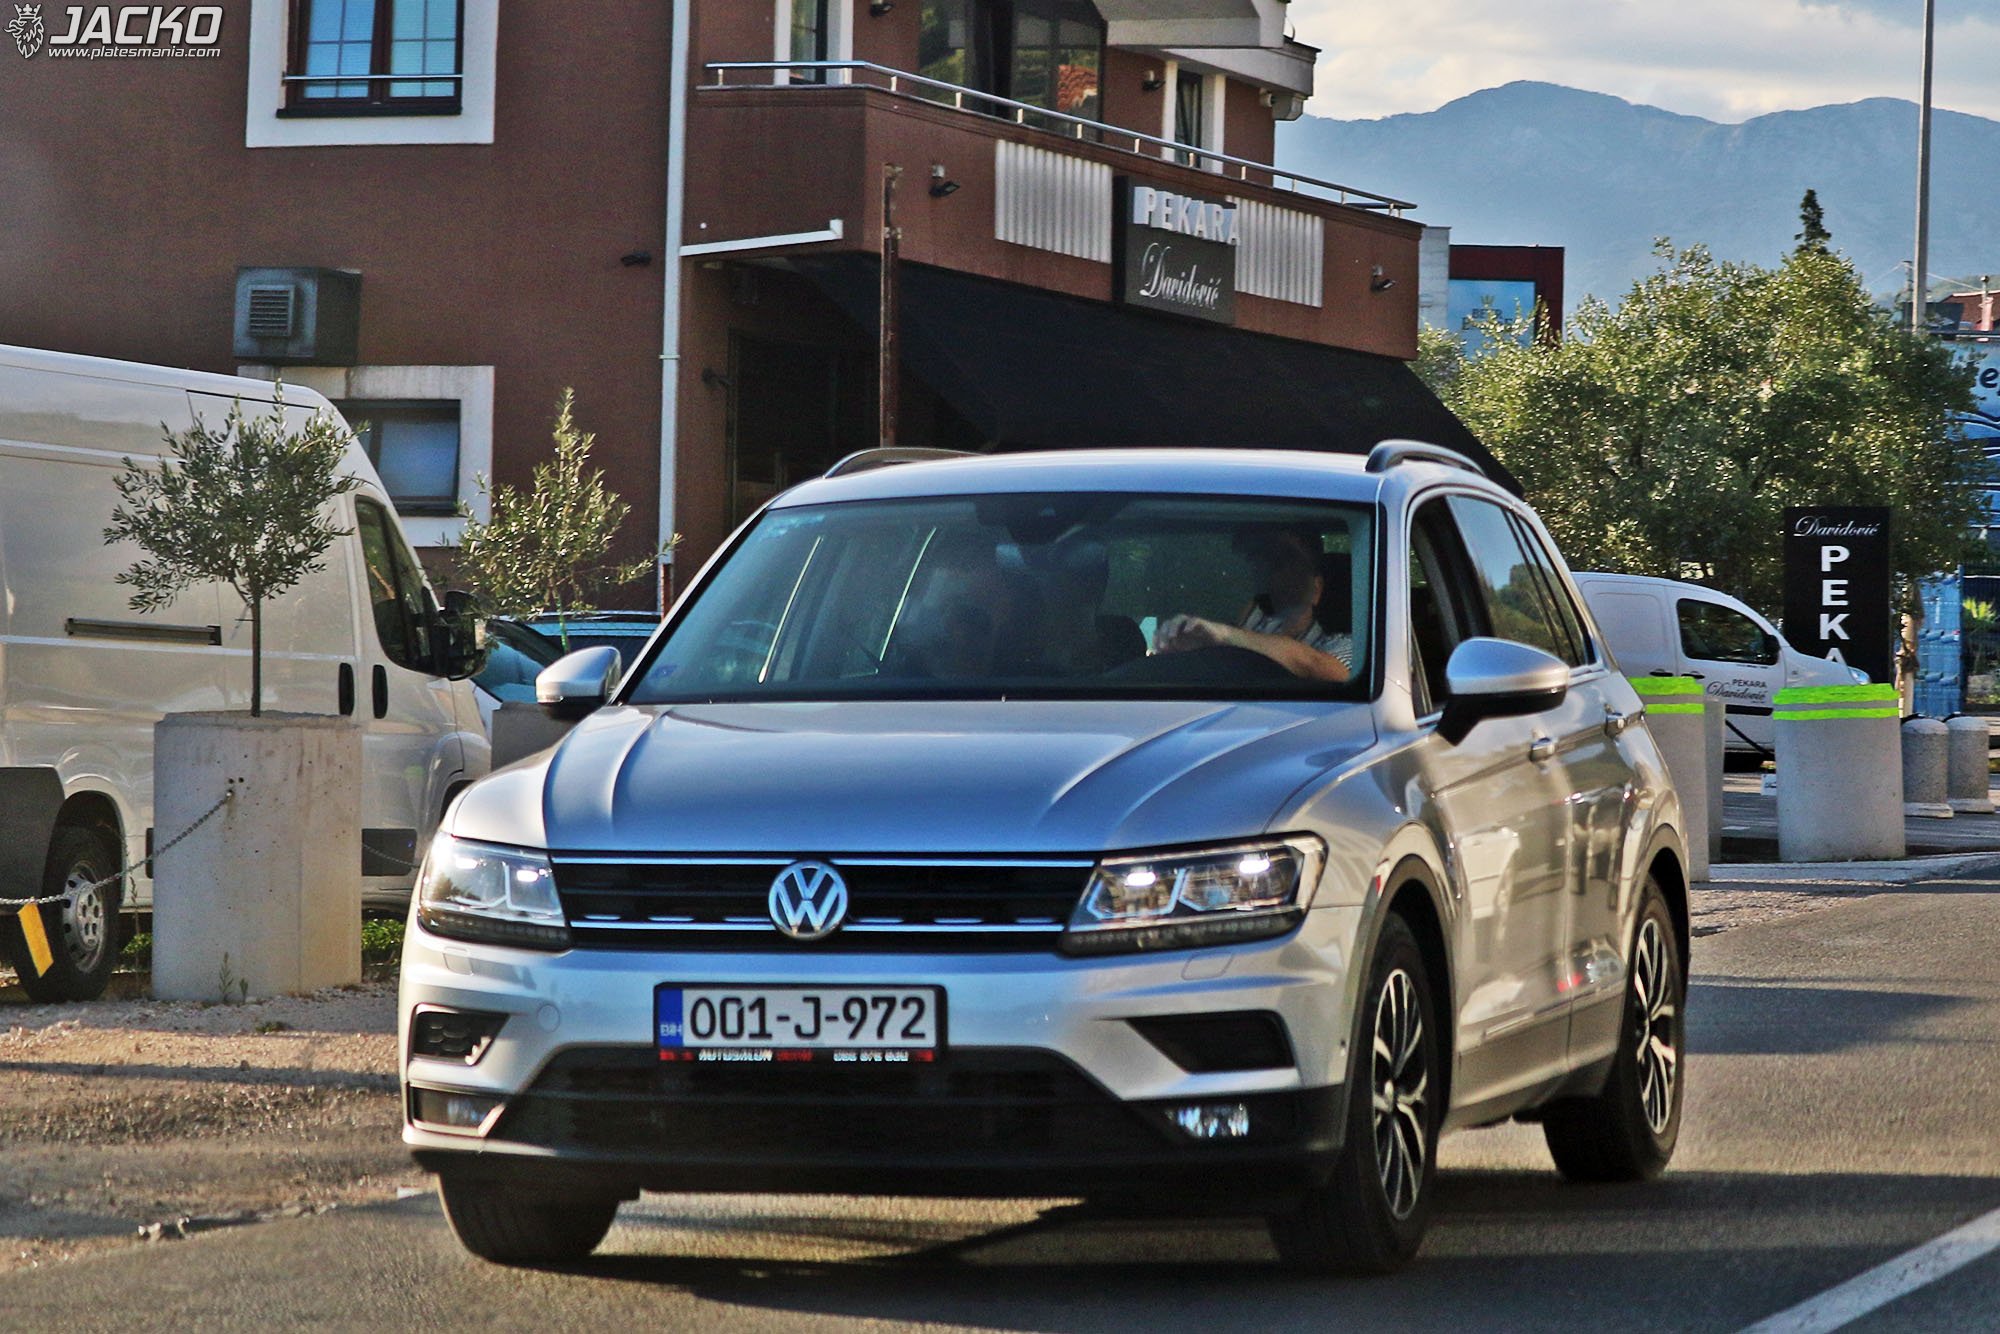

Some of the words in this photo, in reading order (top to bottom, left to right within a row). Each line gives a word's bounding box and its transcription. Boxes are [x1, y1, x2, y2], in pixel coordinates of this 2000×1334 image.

[1133, 186, 1241, 246] PEKARA
[1139, 242, 1221, 310] Davidović
[1793, 515, 1881, 537] Davidović
[1732, 679, 1767, 688] PEKARA
[690, 996, 926, 1040] 001-J-972
